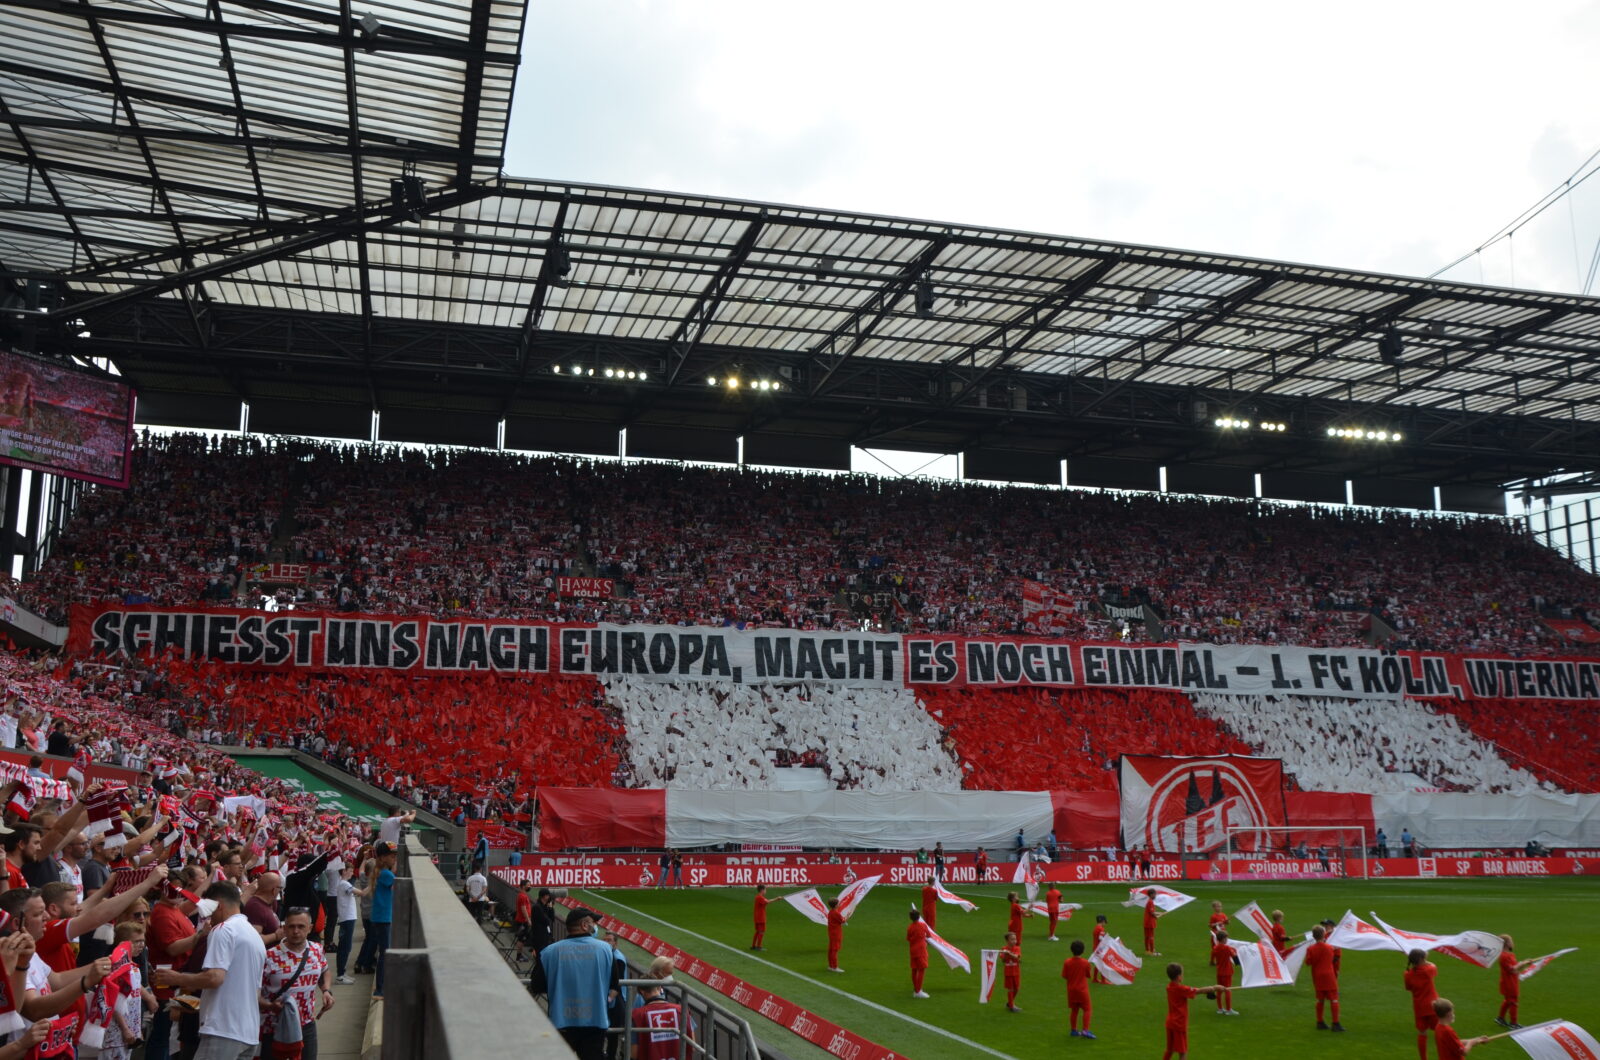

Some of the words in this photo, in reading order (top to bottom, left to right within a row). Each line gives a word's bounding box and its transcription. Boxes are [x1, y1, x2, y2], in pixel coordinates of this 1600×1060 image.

[559, 577, 612, 594] HAWKS
[1104, 603, 1145, 620] TROIKA
[91, 611, 320, 666] SCHIESST
[324, 618, 420, 670] UNS
[424, 621, 550, 673] NACH
[560, 626, 742, 684] EUROPA,
[754, 636, 898, 681] MACHT
[908, 640, 958, 684] ES
[965, 641, 1074, 684] NOCH
[1081, 645, 1229, 689] EINMAL
[1308, 654, 1354, 691] FC
[546, 868, 605, 884] ANDERS.
[726, 868, 753, 883] BAR
[756, 867, 811, 883] ANDERS.
[952, 866, 1003, 881] ANDRS.
[1108, 864, 1130, 879] BAR
